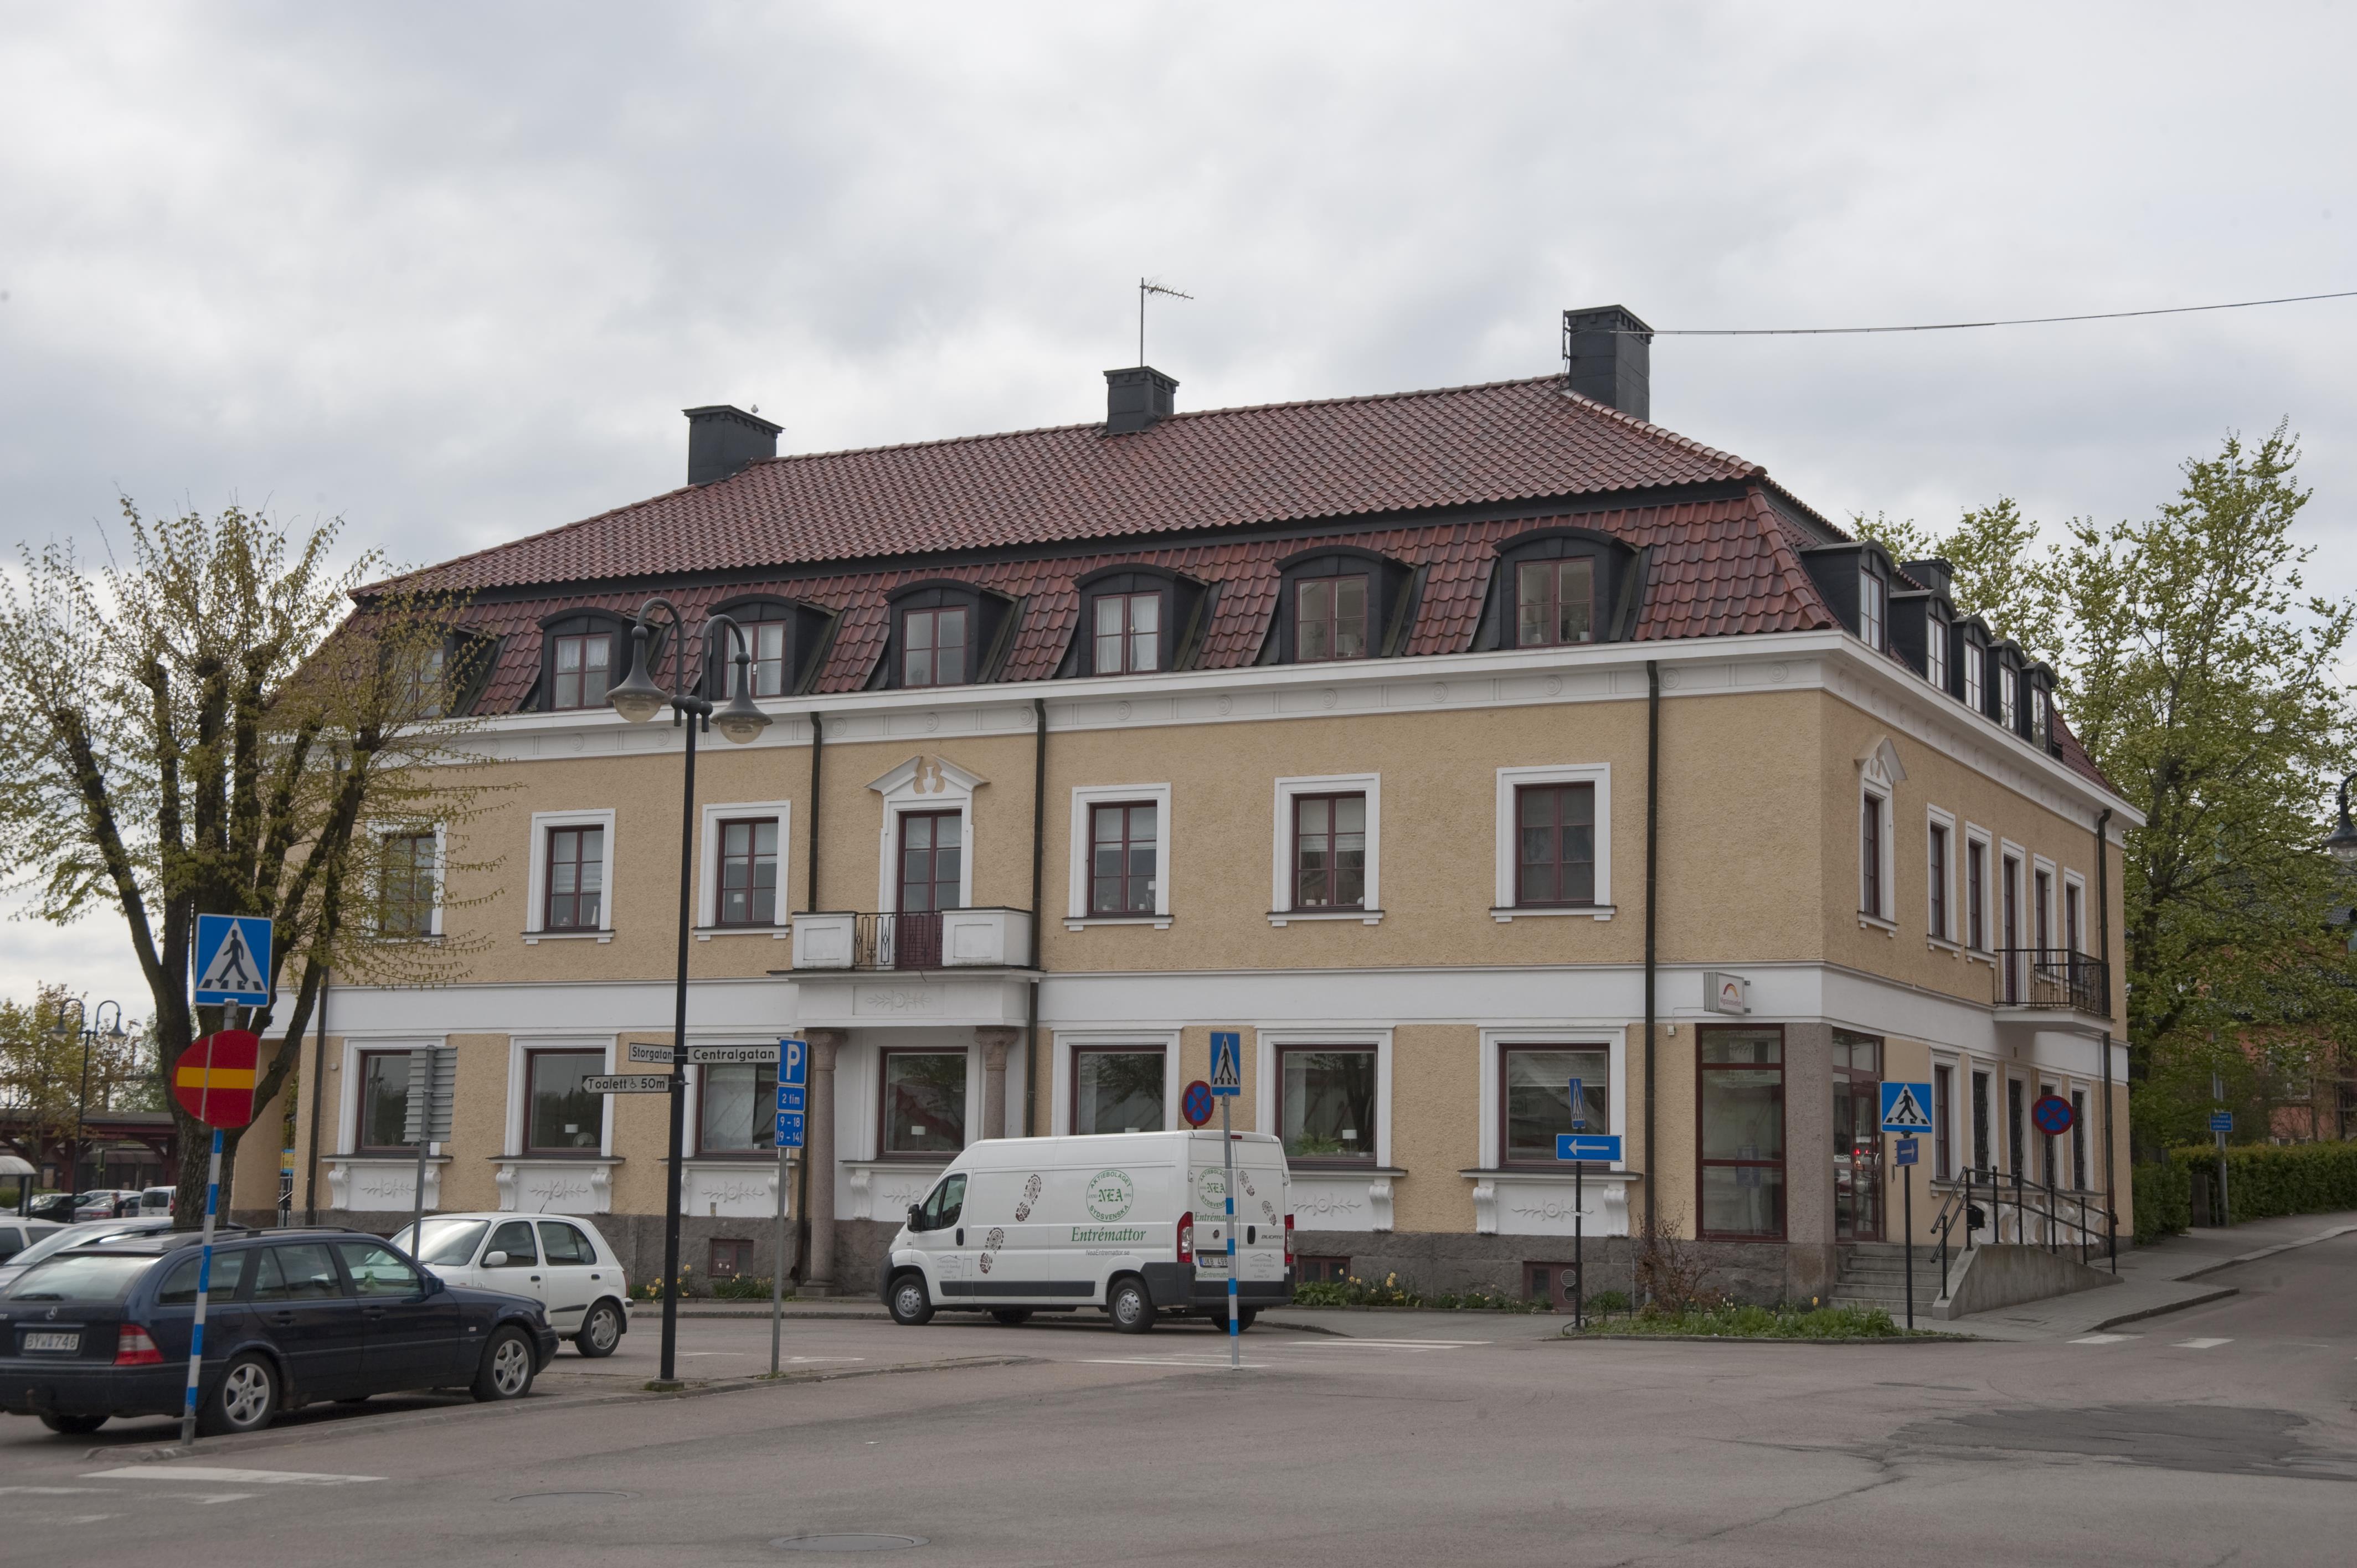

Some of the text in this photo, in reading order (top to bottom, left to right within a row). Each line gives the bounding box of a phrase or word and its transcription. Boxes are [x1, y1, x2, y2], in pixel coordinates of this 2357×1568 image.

[632, 1046, 672, 1061] Storgatan
[693, 1048, 775, 1062] Centralgatan
[786, 1044, 801, 1080] P
[588, 1078, 665, 1089] Toalett 50m
[782, 1094, 800, 1105] 2 tim
[780, 1116, 785, 1127] 9
[794, 1117, 800, 1127] 18
[793, 1132, 802, 1143] 14)
[1090, 1171, 1131, 1189] AKTIEBOLAGET
[1098, 1188, 1123, 1202] NEA
[1207, 1183, 1226, 1193] NEA
[1089, 1205, 1129, 1220] SYDSVENSKA
[1071, 1226, 1146, 1241] Entrémattor
[55, 1335, 77, 1348] 746
